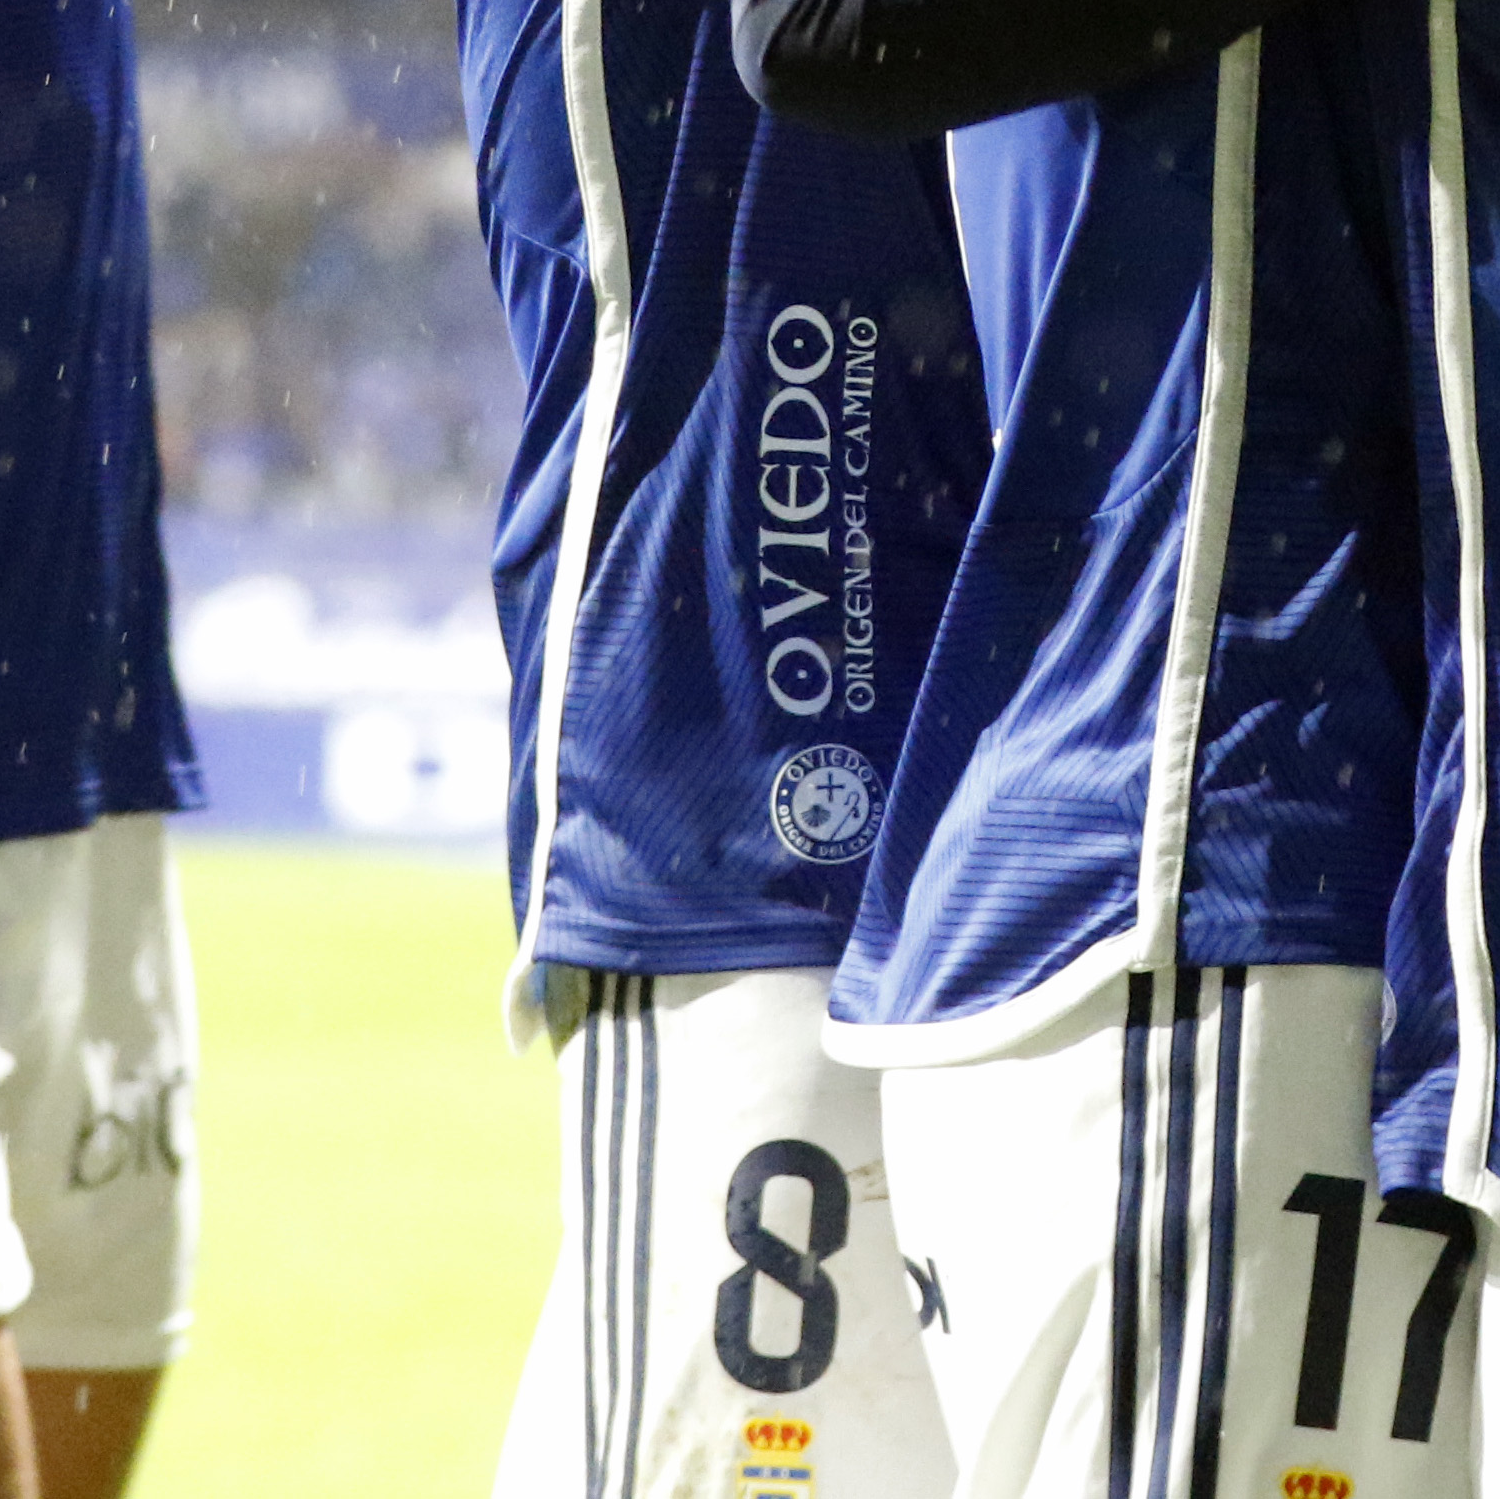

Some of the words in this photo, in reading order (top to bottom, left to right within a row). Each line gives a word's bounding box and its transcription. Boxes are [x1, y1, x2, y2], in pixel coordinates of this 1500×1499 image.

[842, 316, 878, 477] CAMINO
[758, 304, 836, 716] OVIEDO
[843, 484, 871, 555] DEL
[843, 565, 876, 714] ORIGEN
[786, 748, 873, 782] OVIEDO
[713, 1138, 851, 1394] 8
[1280, 1172, 1478, 1443] 17
